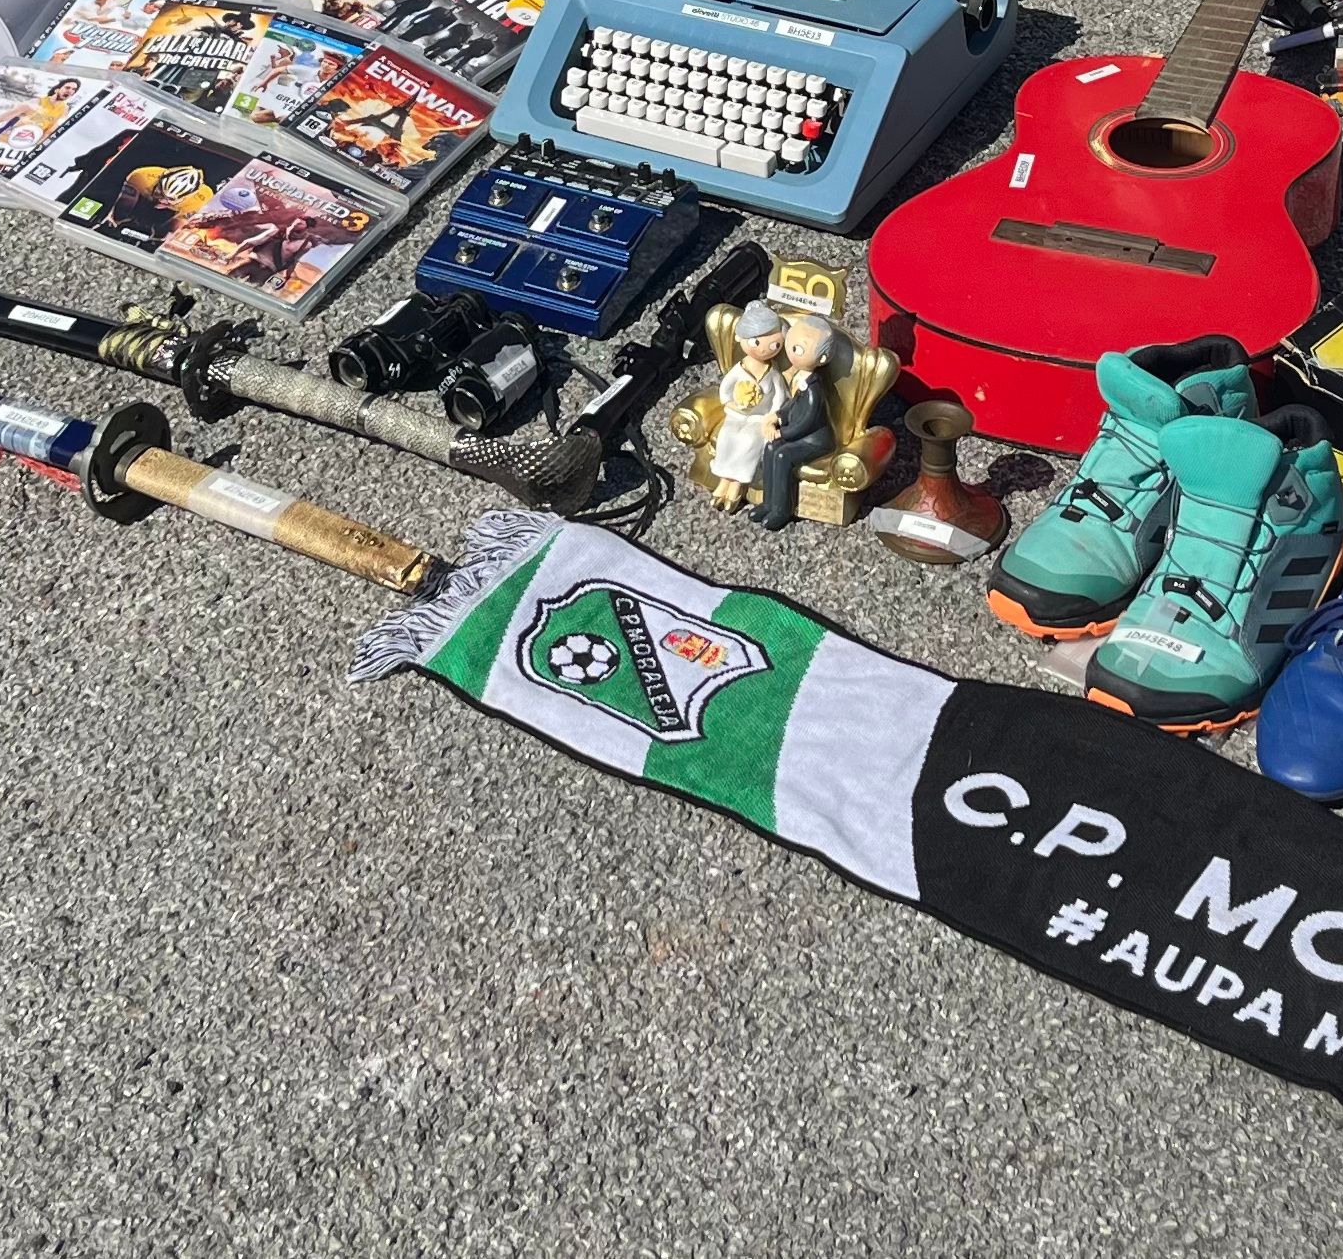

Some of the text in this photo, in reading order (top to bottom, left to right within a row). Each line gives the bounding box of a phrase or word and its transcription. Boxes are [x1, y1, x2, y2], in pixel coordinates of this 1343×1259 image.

[356, 16, 377, 31] 18
[145, 34, 193, 55] CALL
[240, 95, 251, 107] 3
[364, 60, 475, 127] ENDWAR
[166, 124, 204, 145] PS3
[274, 159, 311, 179] PS3
[81, 201, 95, 214] 3
[245, 167, 351, 220] UNCHARTED
[340, 211, 371, 233] 3
[777, 267, 836, 300] 50
[942, 771, 1127, 889] C.P.
[1044, 897, 1284, 1036] #AUPA
